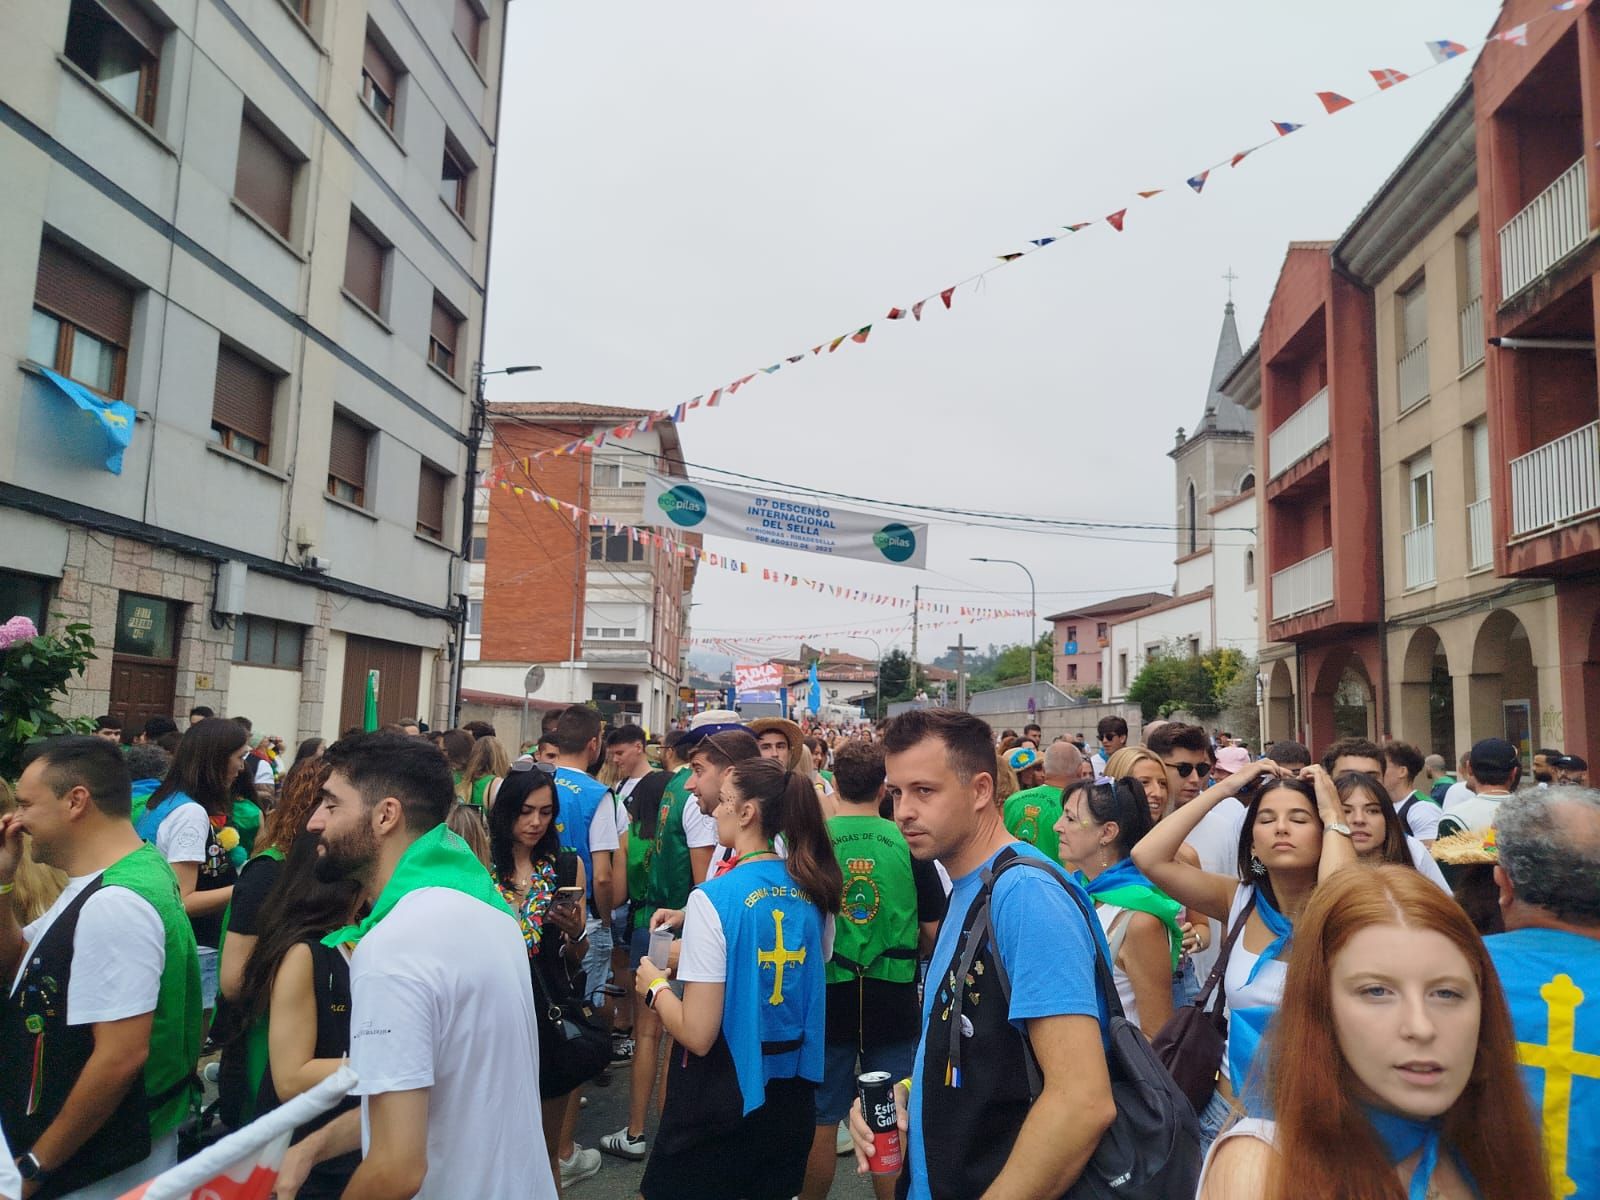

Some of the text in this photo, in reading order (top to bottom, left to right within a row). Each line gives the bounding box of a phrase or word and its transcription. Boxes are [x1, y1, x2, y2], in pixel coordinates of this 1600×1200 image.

[772, 501, 830, 518] DESCENSO
[748, 506, 836, 529] INTERNACIONAL
[762, 519, 820, 536] DEL SELLA
[771, 537, 798, 548] AGOSTO
[833, 833, 860, 847] ANGAS
[862, 832, 874, 840] DE
[772, 886, 788, 897] DE
[874, 1102, 896, 1116] Estr
[876, 1113, 898, 1128] Gali
